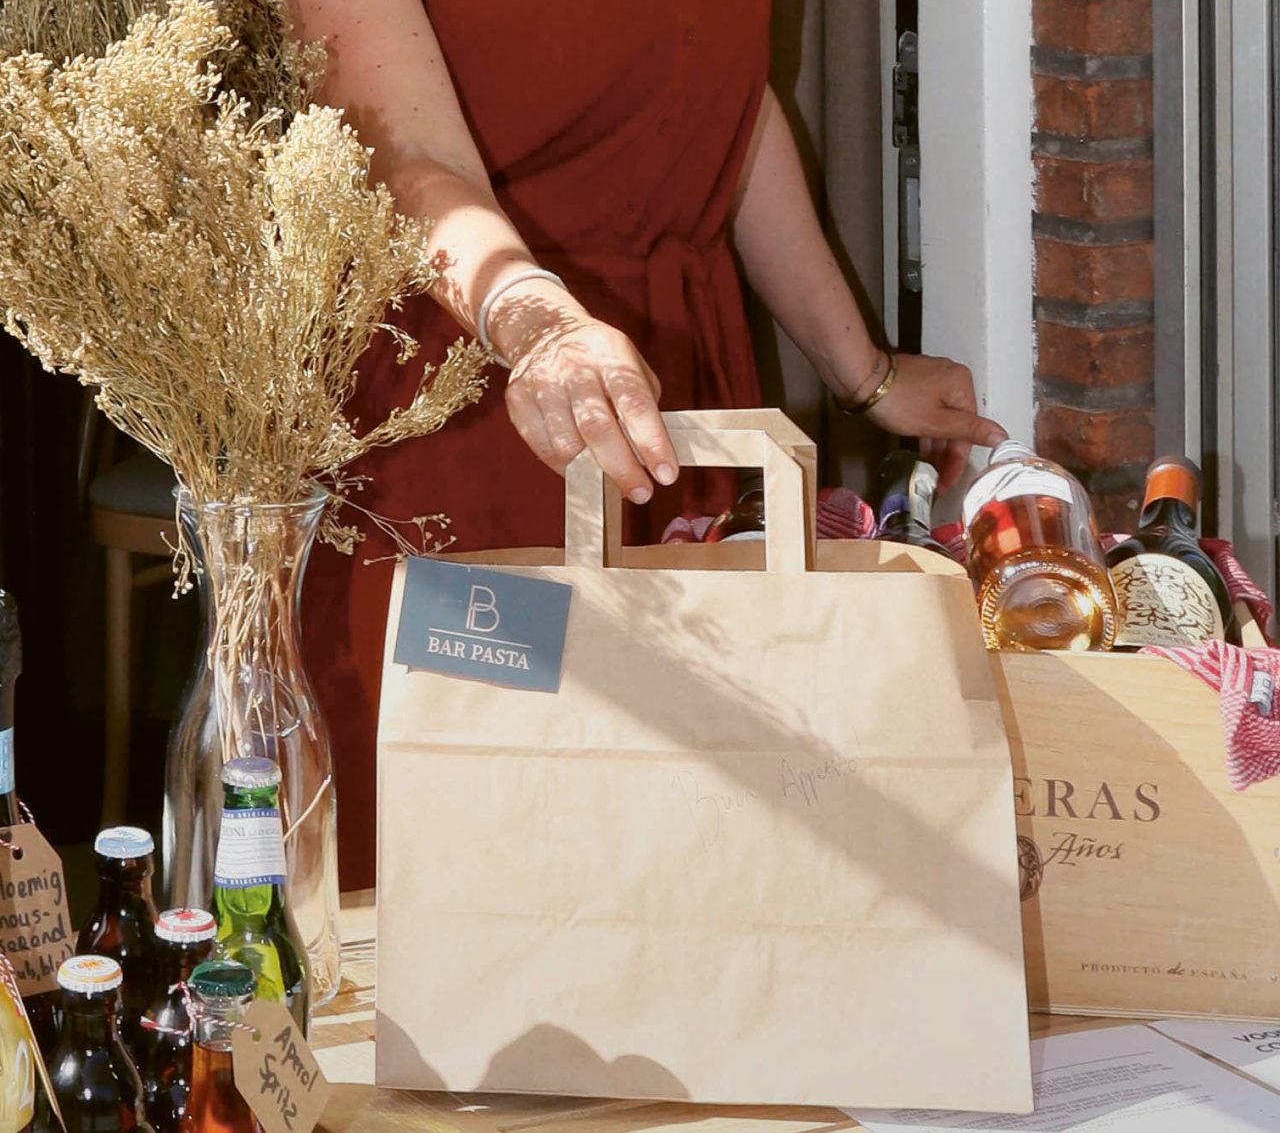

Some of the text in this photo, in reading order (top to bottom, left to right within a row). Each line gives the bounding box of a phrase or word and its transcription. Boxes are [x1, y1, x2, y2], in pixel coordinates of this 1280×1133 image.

[427, 636, 531, 670] BAR PASTA
[1043, 831, 1126, 866] Años
[1080, 961, 1249, 980] PRODUCTO de ESPAÑA
[1232, 1030, 1280, 1043] VOO
